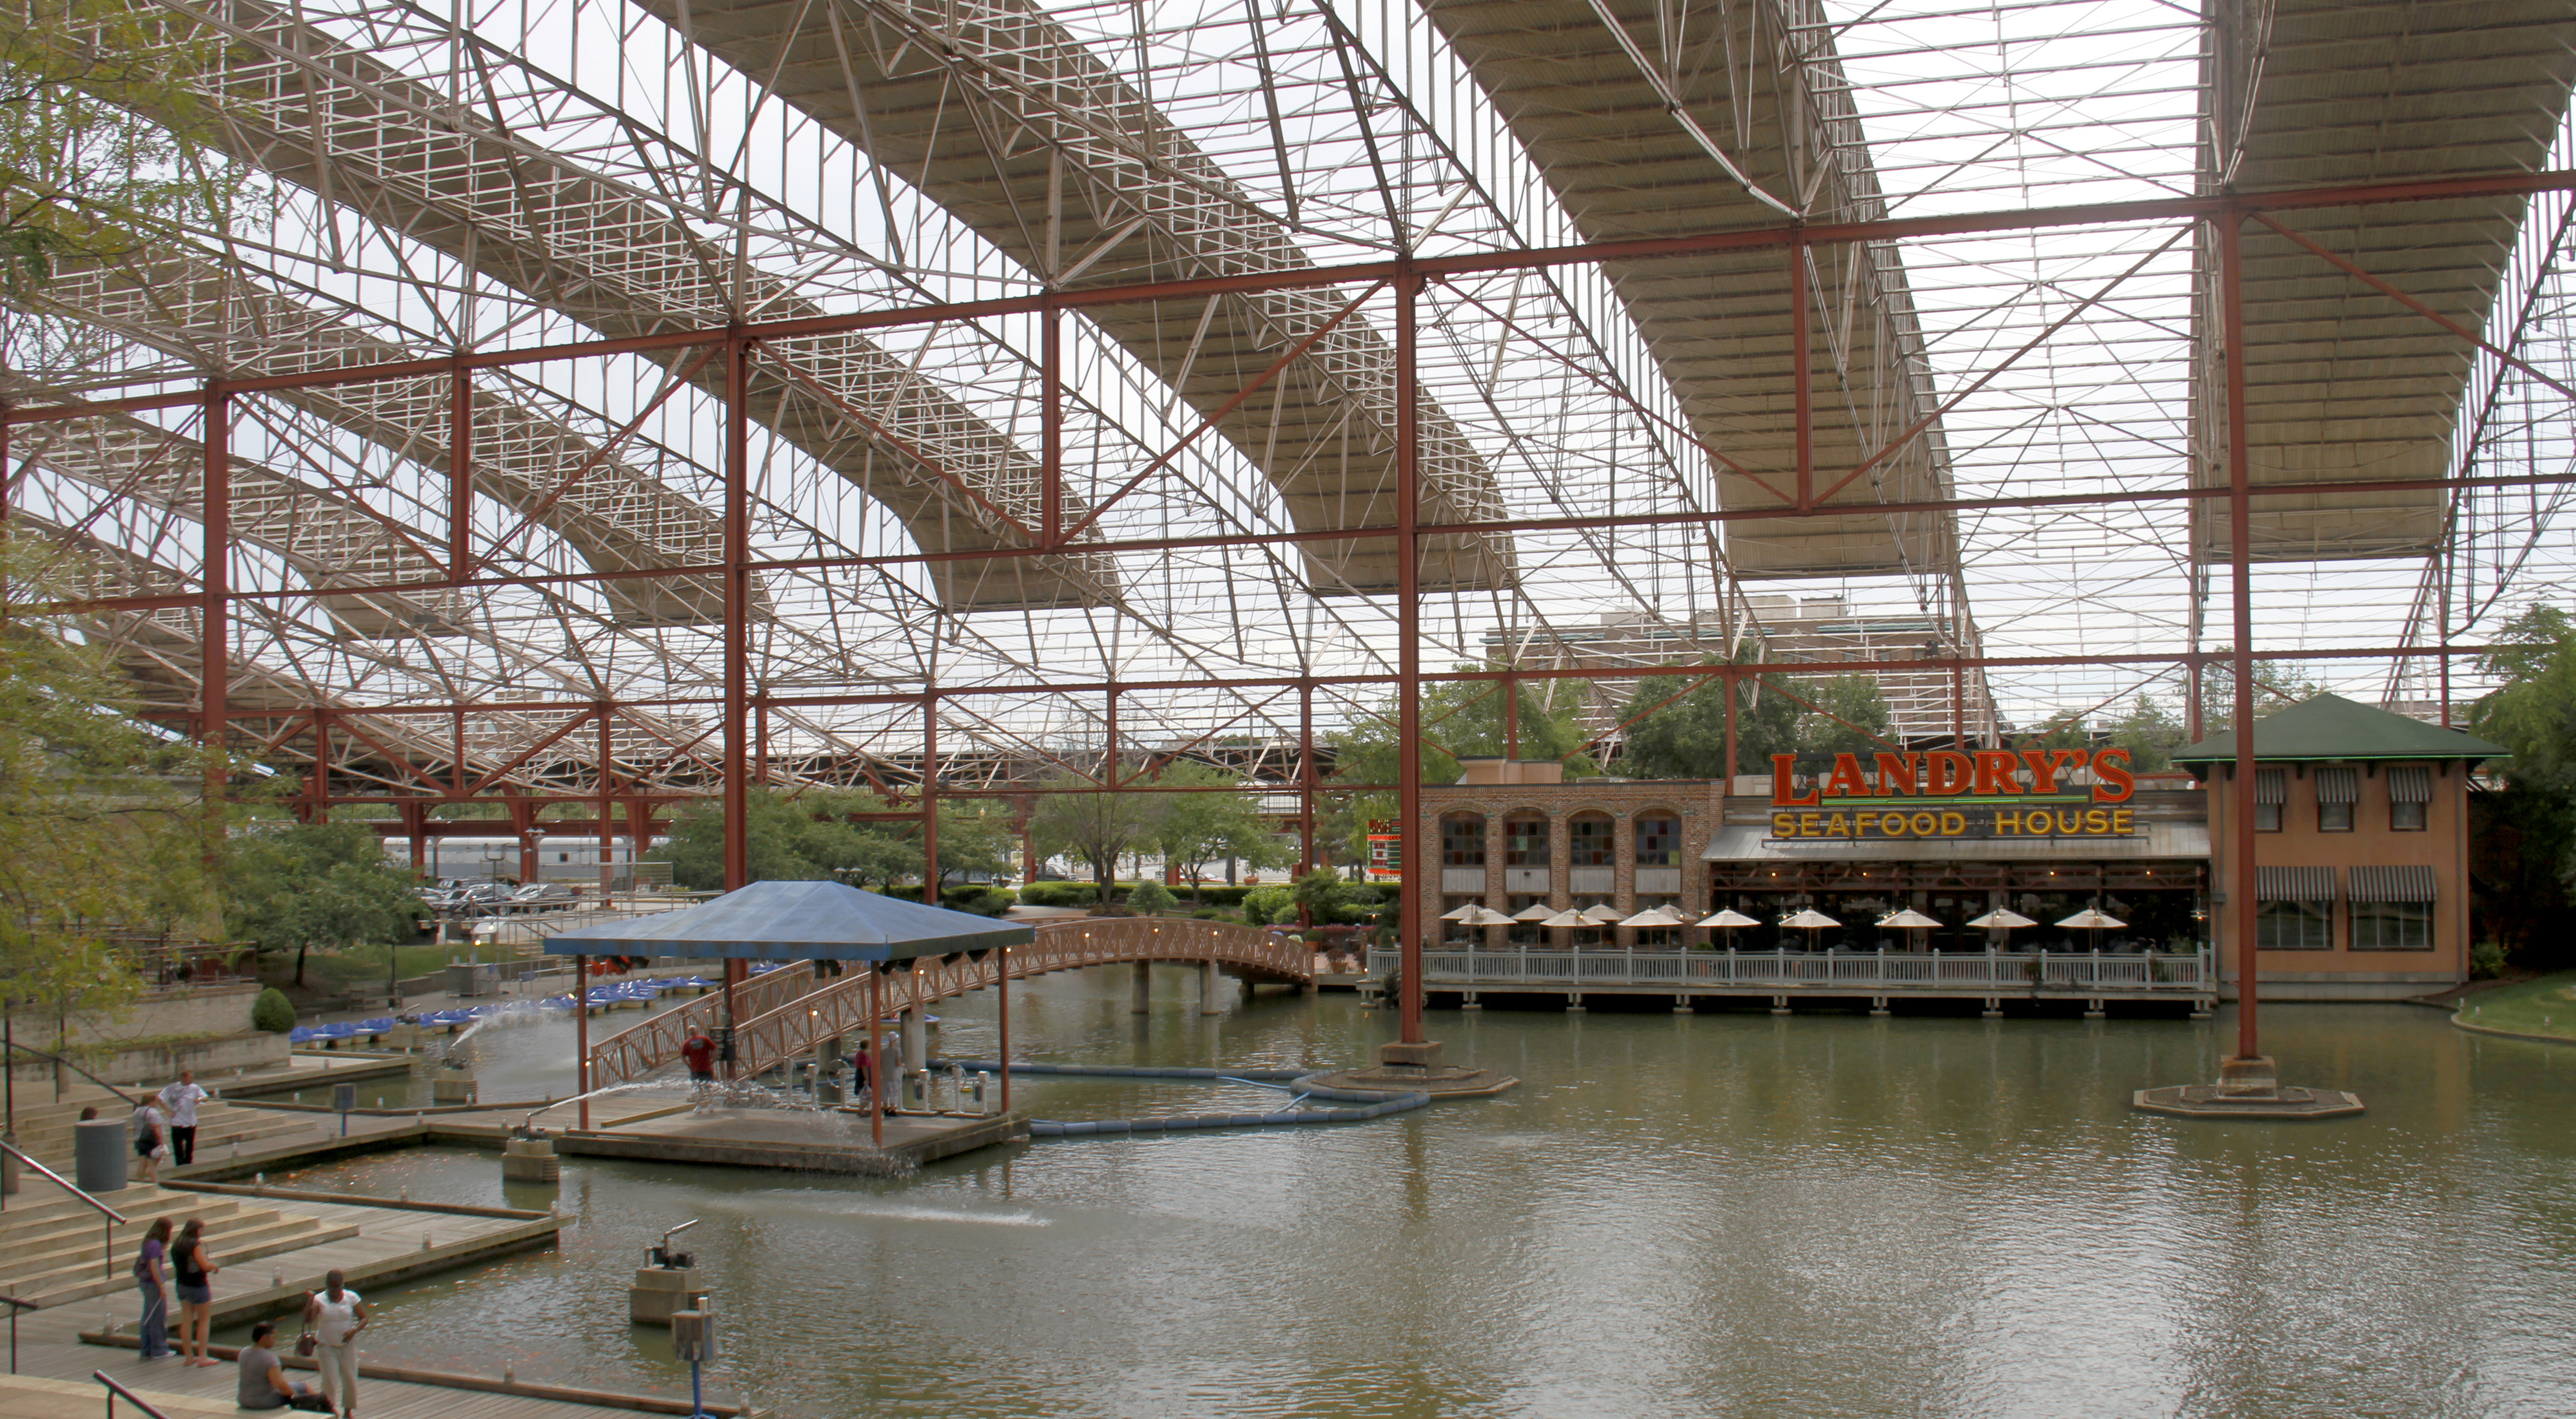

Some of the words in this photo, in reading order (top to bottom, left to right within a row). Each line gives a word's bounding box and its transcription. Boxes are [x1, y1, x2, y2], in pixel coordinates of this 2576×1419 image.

[1771, 748, 2135, 807] LANDRY'S
[1772, 810, 1967, 837] SEAFOOD
[1995, 808, 2135, 835] HOUSE
